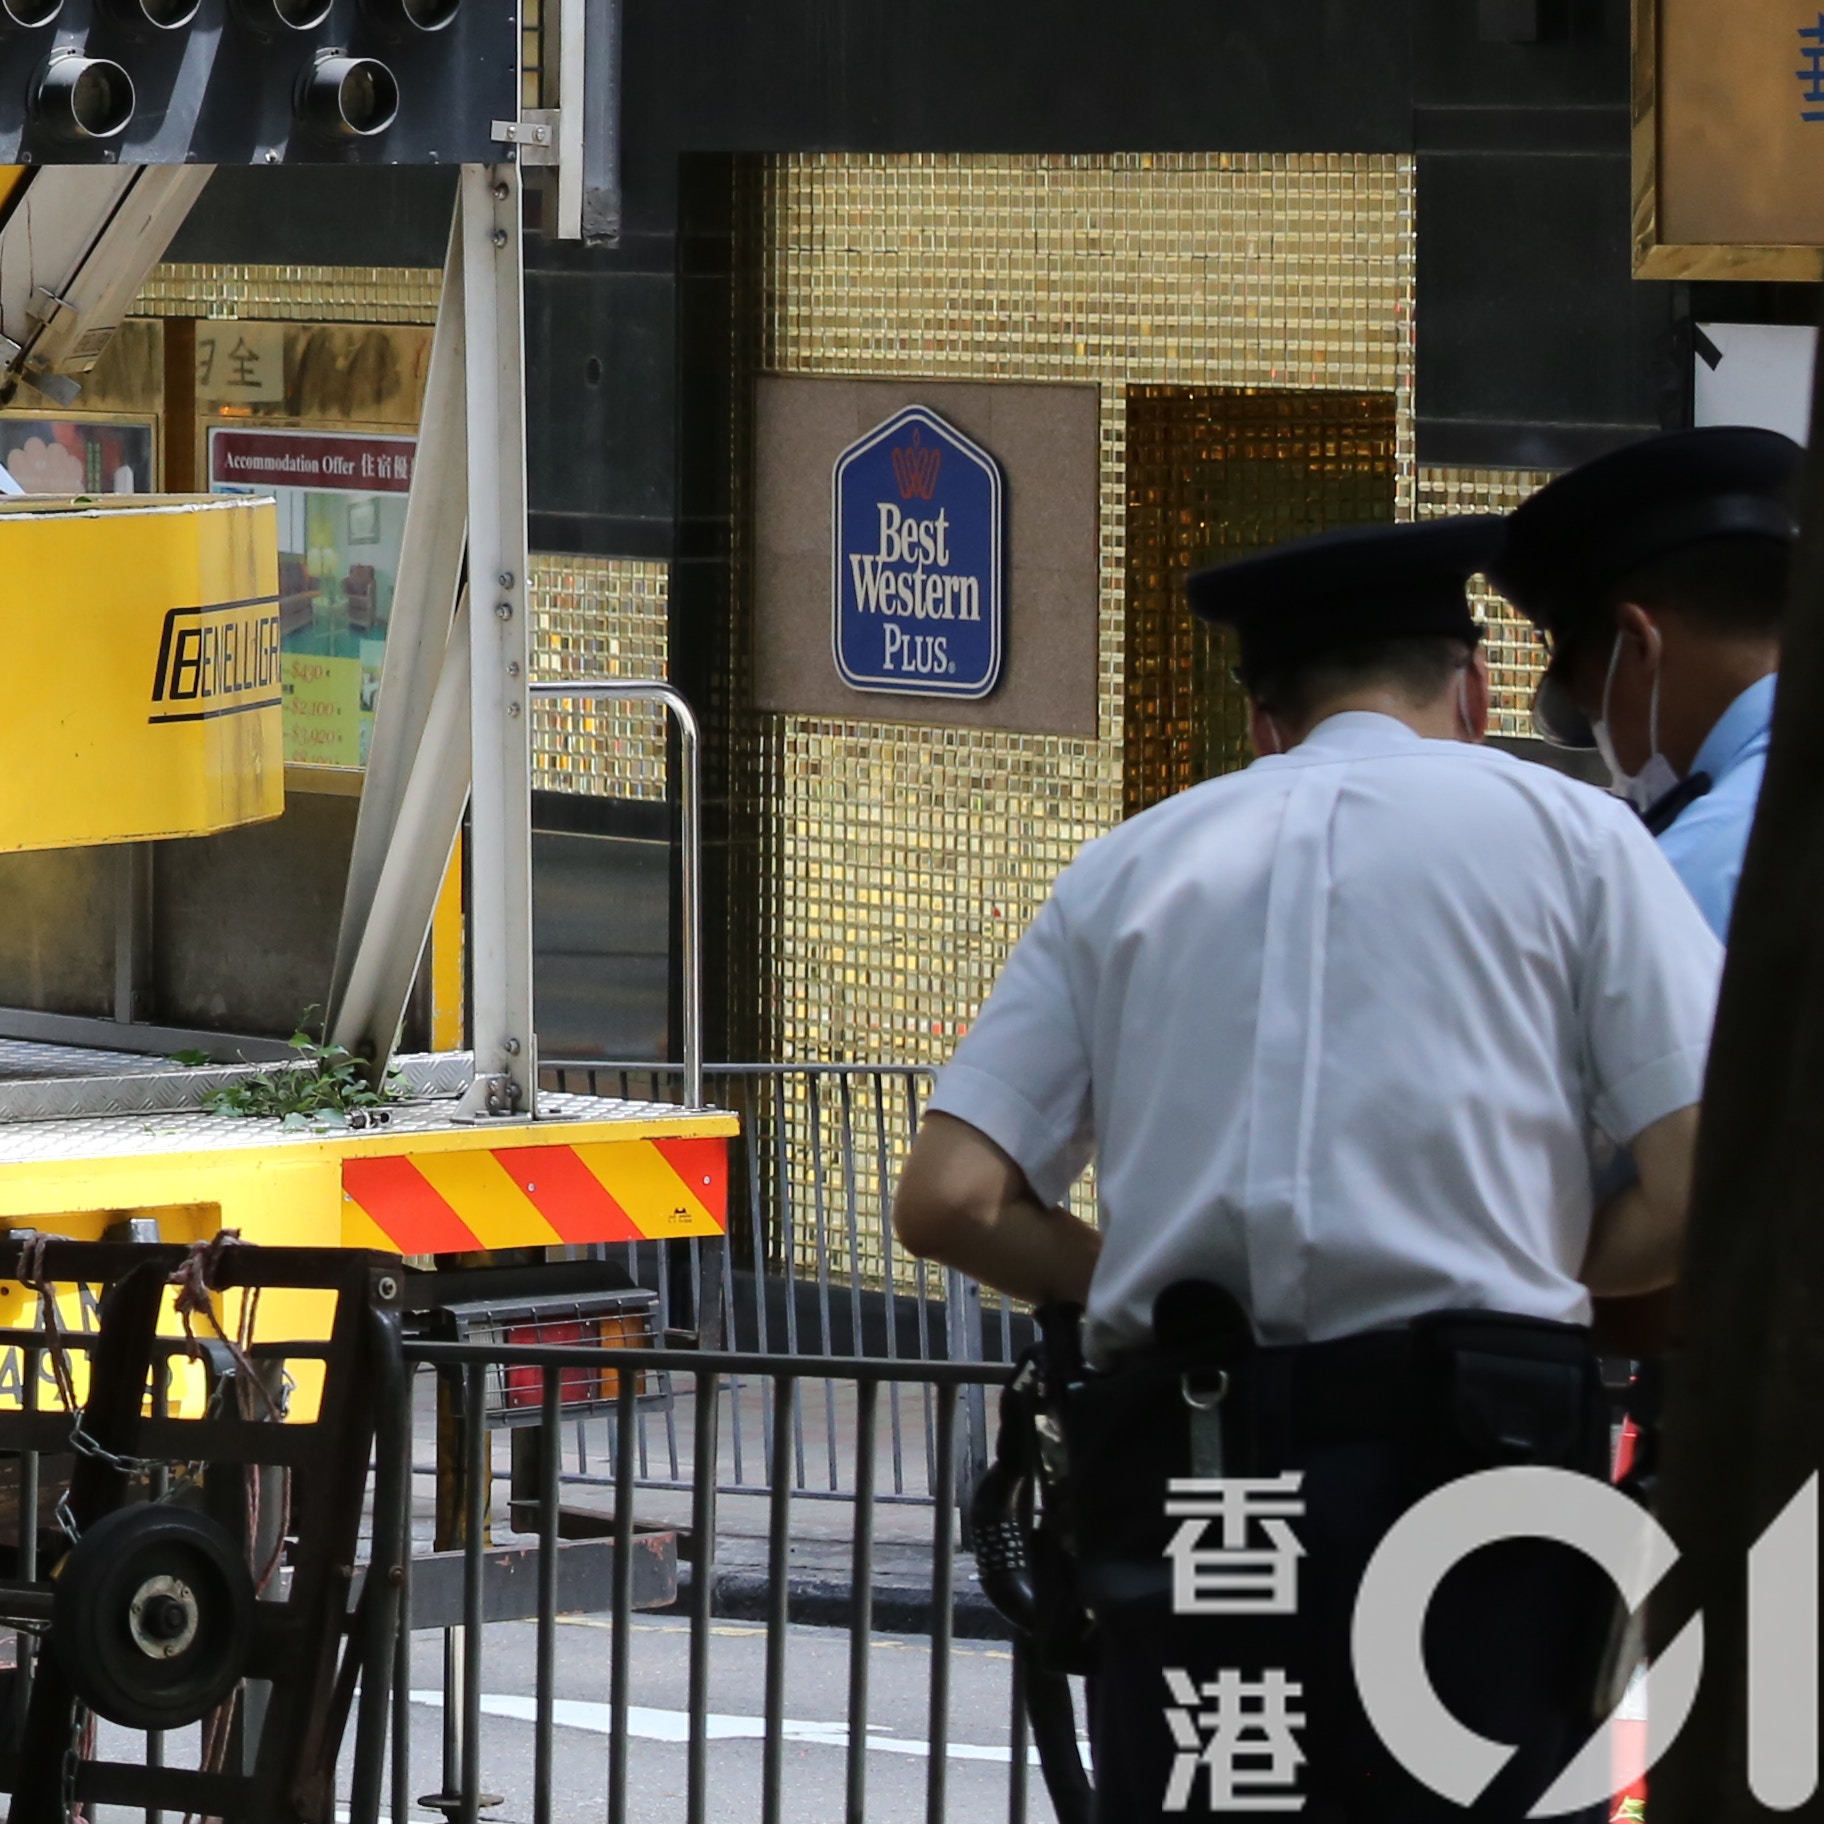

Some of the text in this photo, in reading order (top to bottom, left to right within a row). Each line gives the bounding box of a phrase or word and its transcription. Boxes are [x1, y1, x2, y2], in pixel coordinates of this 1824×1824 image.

[225, 451, 415, 481] Accommodation Offer 住宿優
[877, 502, 949, 567] Best
[849, 553, 981, 621] Western
